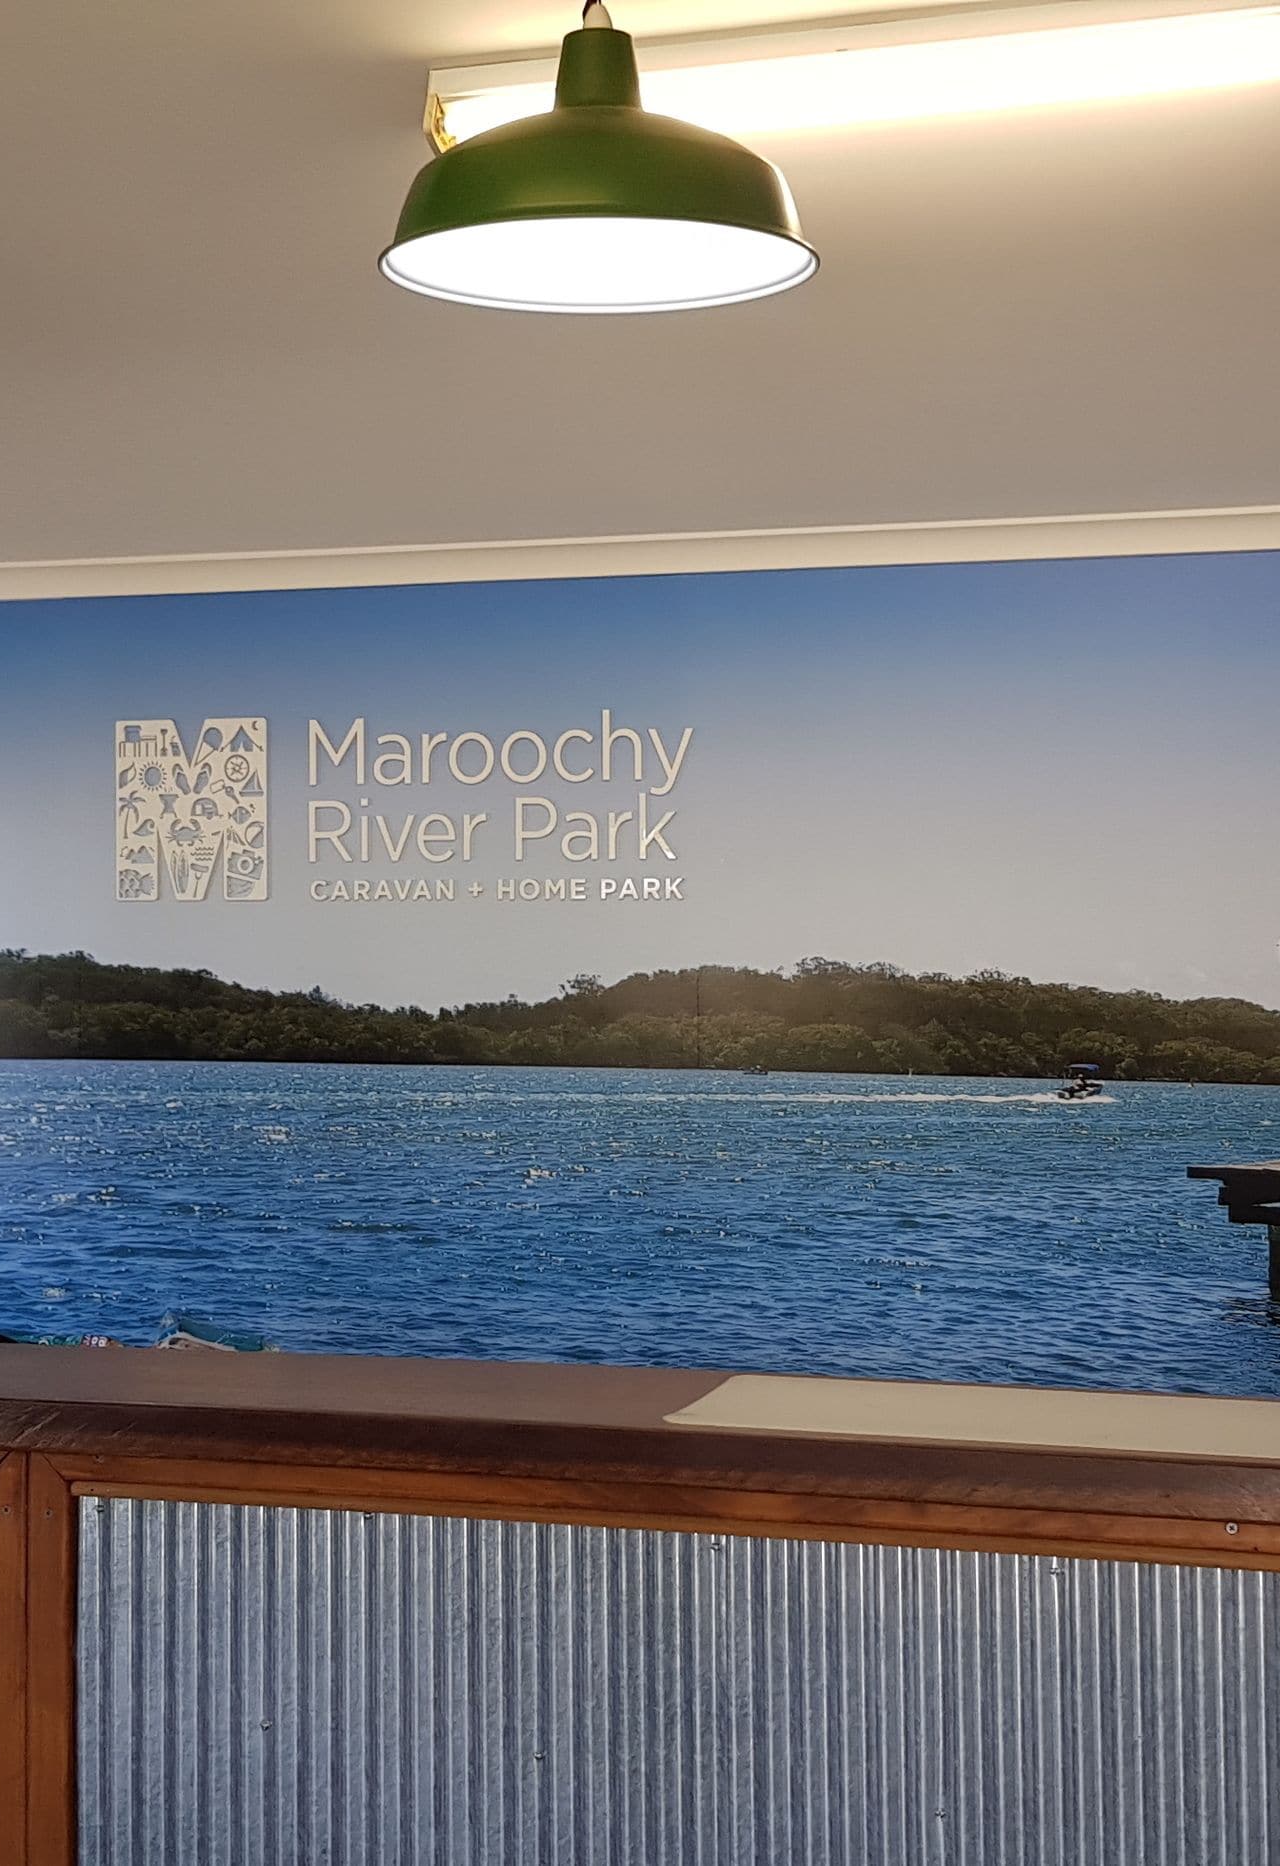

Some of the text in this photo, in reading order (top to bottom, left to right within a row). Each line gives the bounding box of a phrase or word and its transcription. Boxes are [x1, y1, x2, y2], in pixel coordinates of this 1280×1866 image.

[308, 709, 694, 796] Maroochy
[307, 792, 677, 862] River Park
[310, 879, 455, 901] CARAVAN
[497, 878, 587, 901] HOME
[600, 877, 684, 901] PARK
